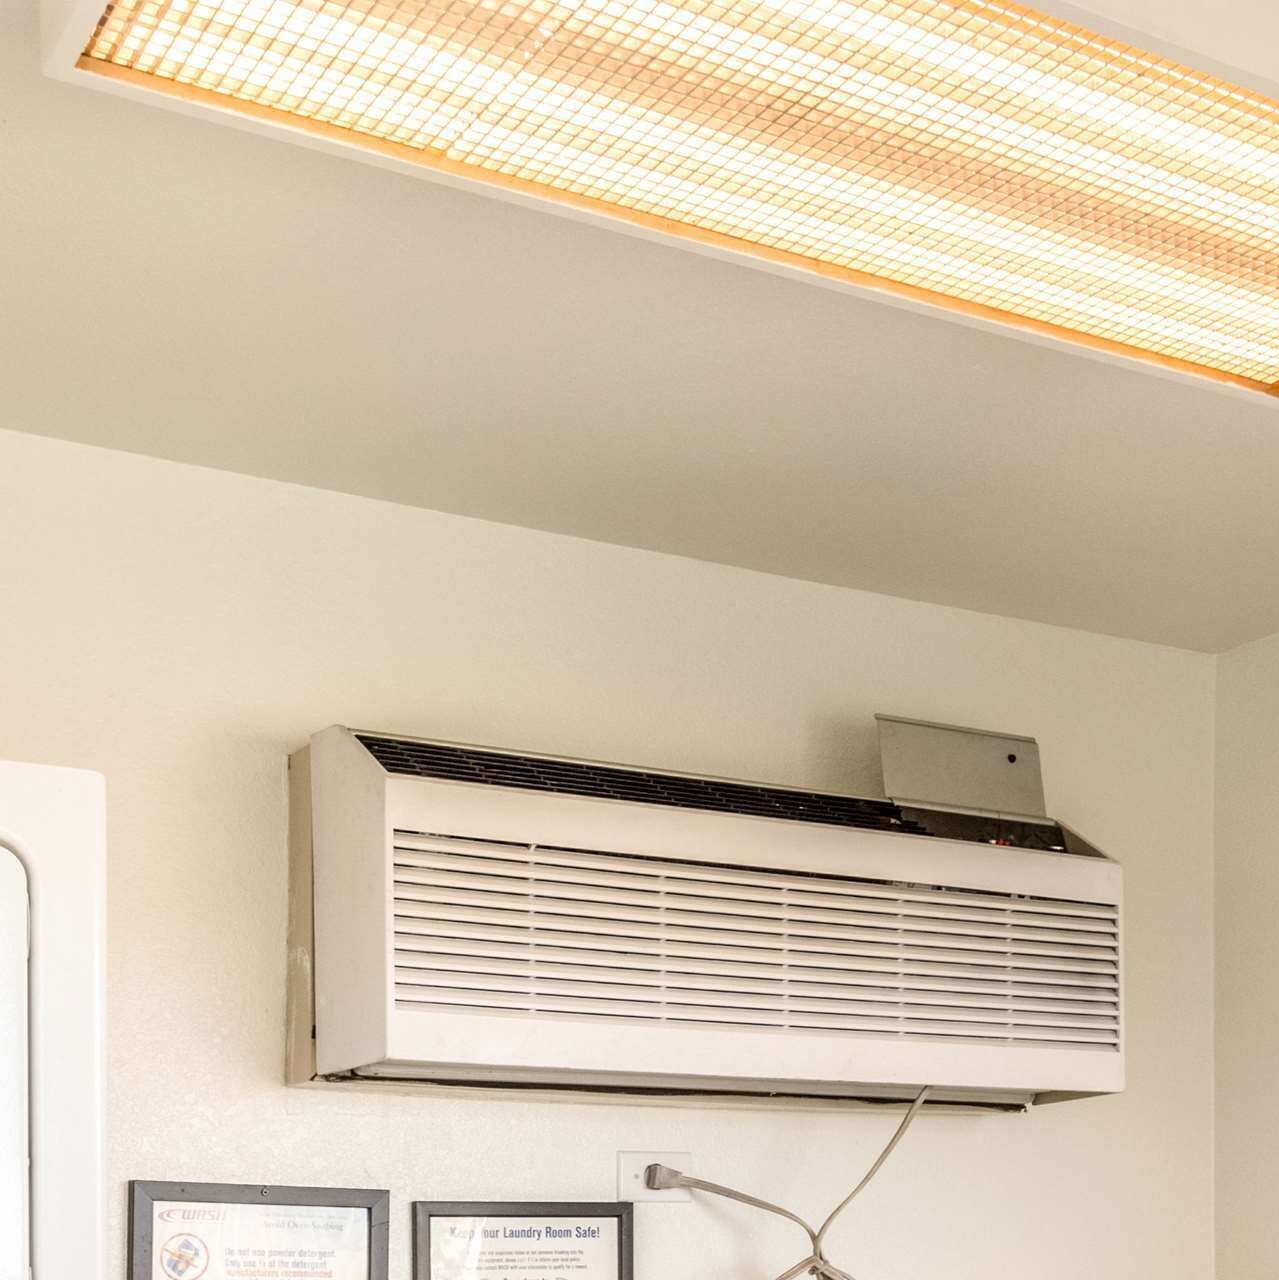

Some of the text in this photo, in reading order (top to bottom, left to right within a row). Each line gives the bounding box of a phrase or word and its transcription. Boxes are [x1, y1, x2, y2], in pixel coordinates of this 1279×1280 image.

[482, 1228, 499, 1238] our
[503, 1227, 542, 1240] Laundry
[545, 1227, 572, 1238] Room
[575, 1226, 600, 1238] Safe!
